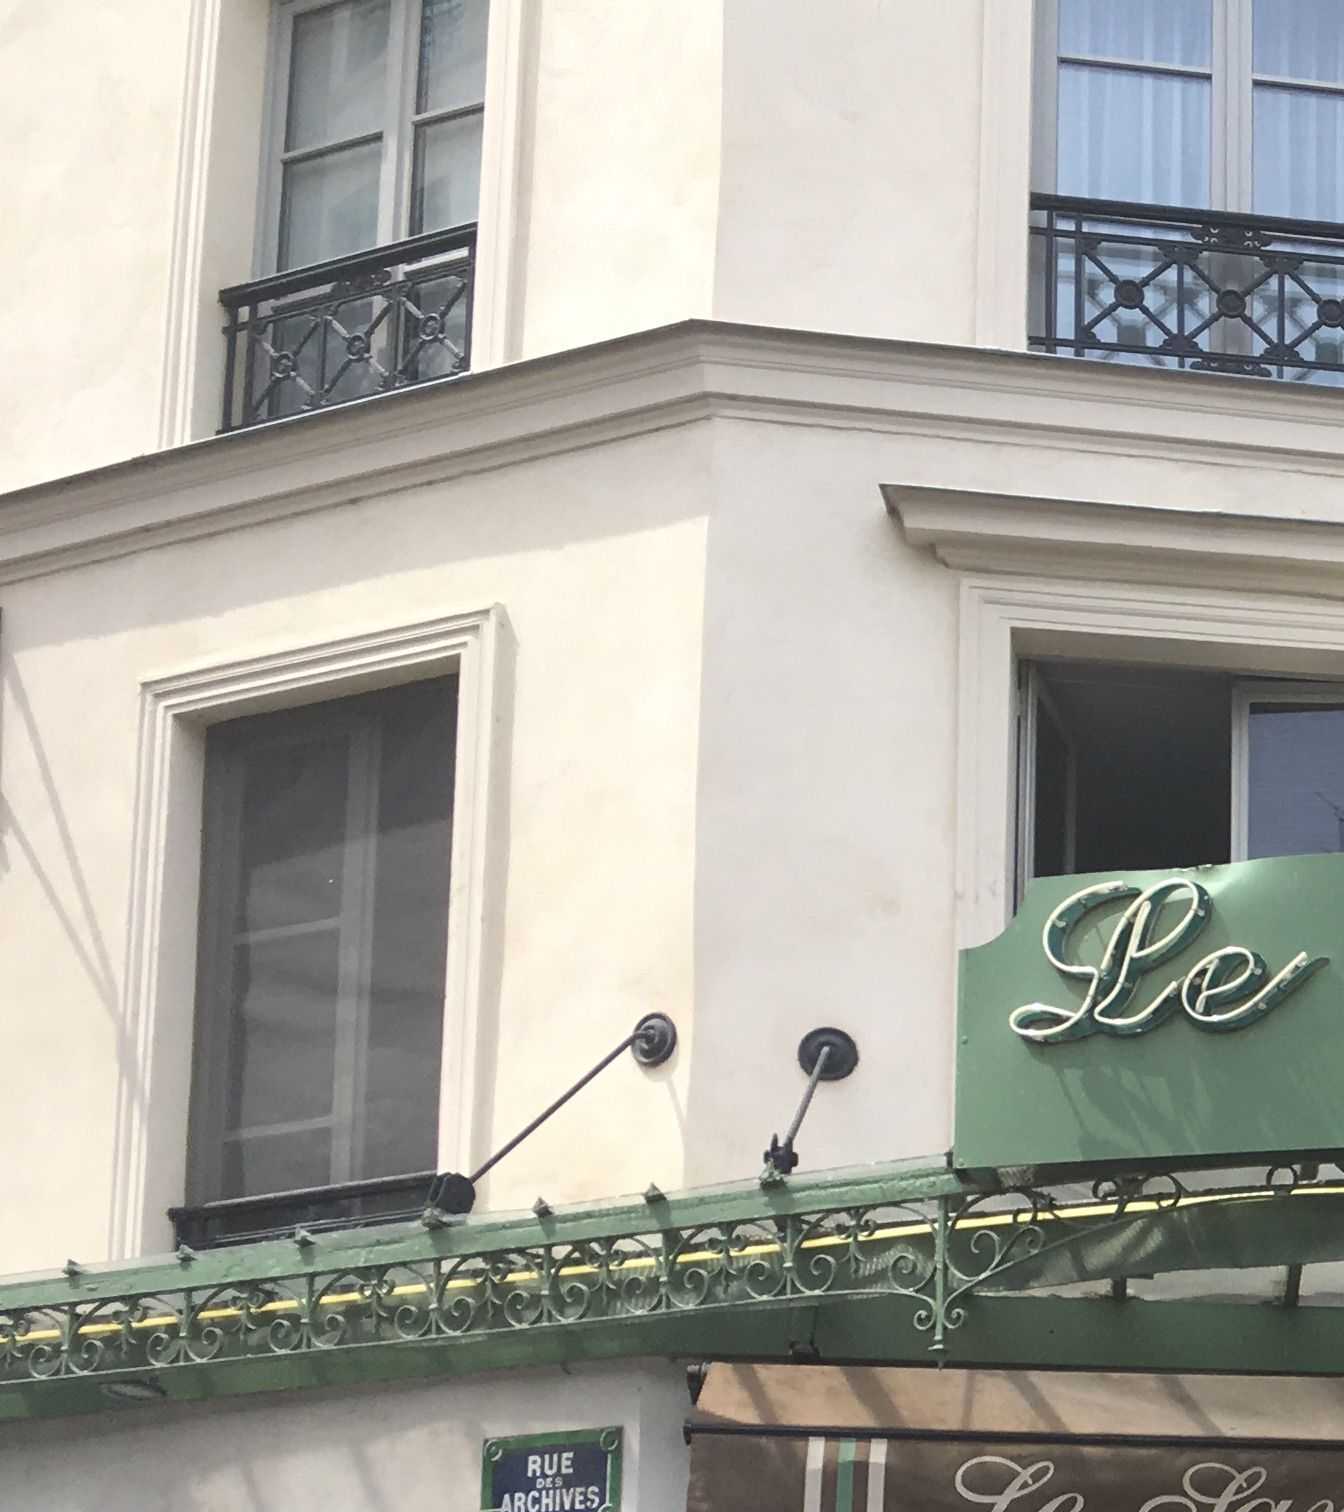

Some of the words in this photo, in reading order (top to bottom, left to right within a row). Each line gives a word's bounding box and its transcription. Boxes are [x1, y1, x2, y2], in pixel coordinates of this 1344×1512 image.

[1008, 878, 1330, 1044] Le
[527, 1452, 574, 1477] RUE
[536, 1477, 563, 1488] DES
